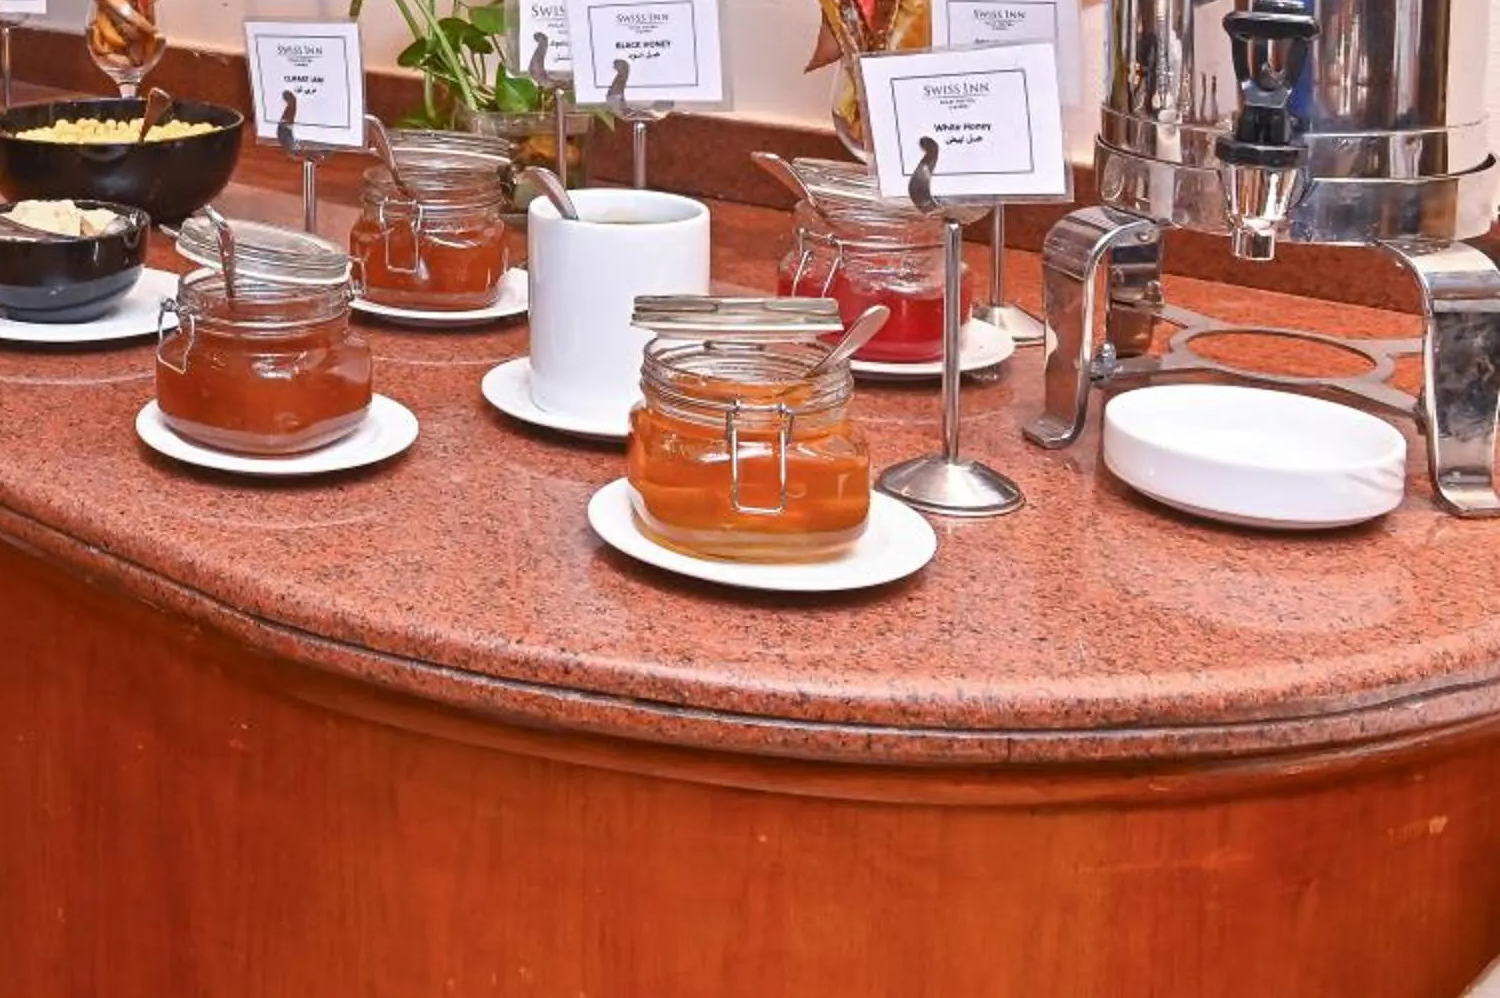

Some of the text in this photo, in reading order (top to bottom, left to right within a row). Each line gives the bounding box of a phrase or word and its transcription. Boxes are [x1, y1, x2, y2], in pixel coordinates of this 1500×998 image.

[615, 12, 669, 22] SWISS INN
[615, 40, 671, 49] BLACK HONEY
[923, 82, 990, 96] SWISS INN
[933, 123, 992, 132] White Honey
